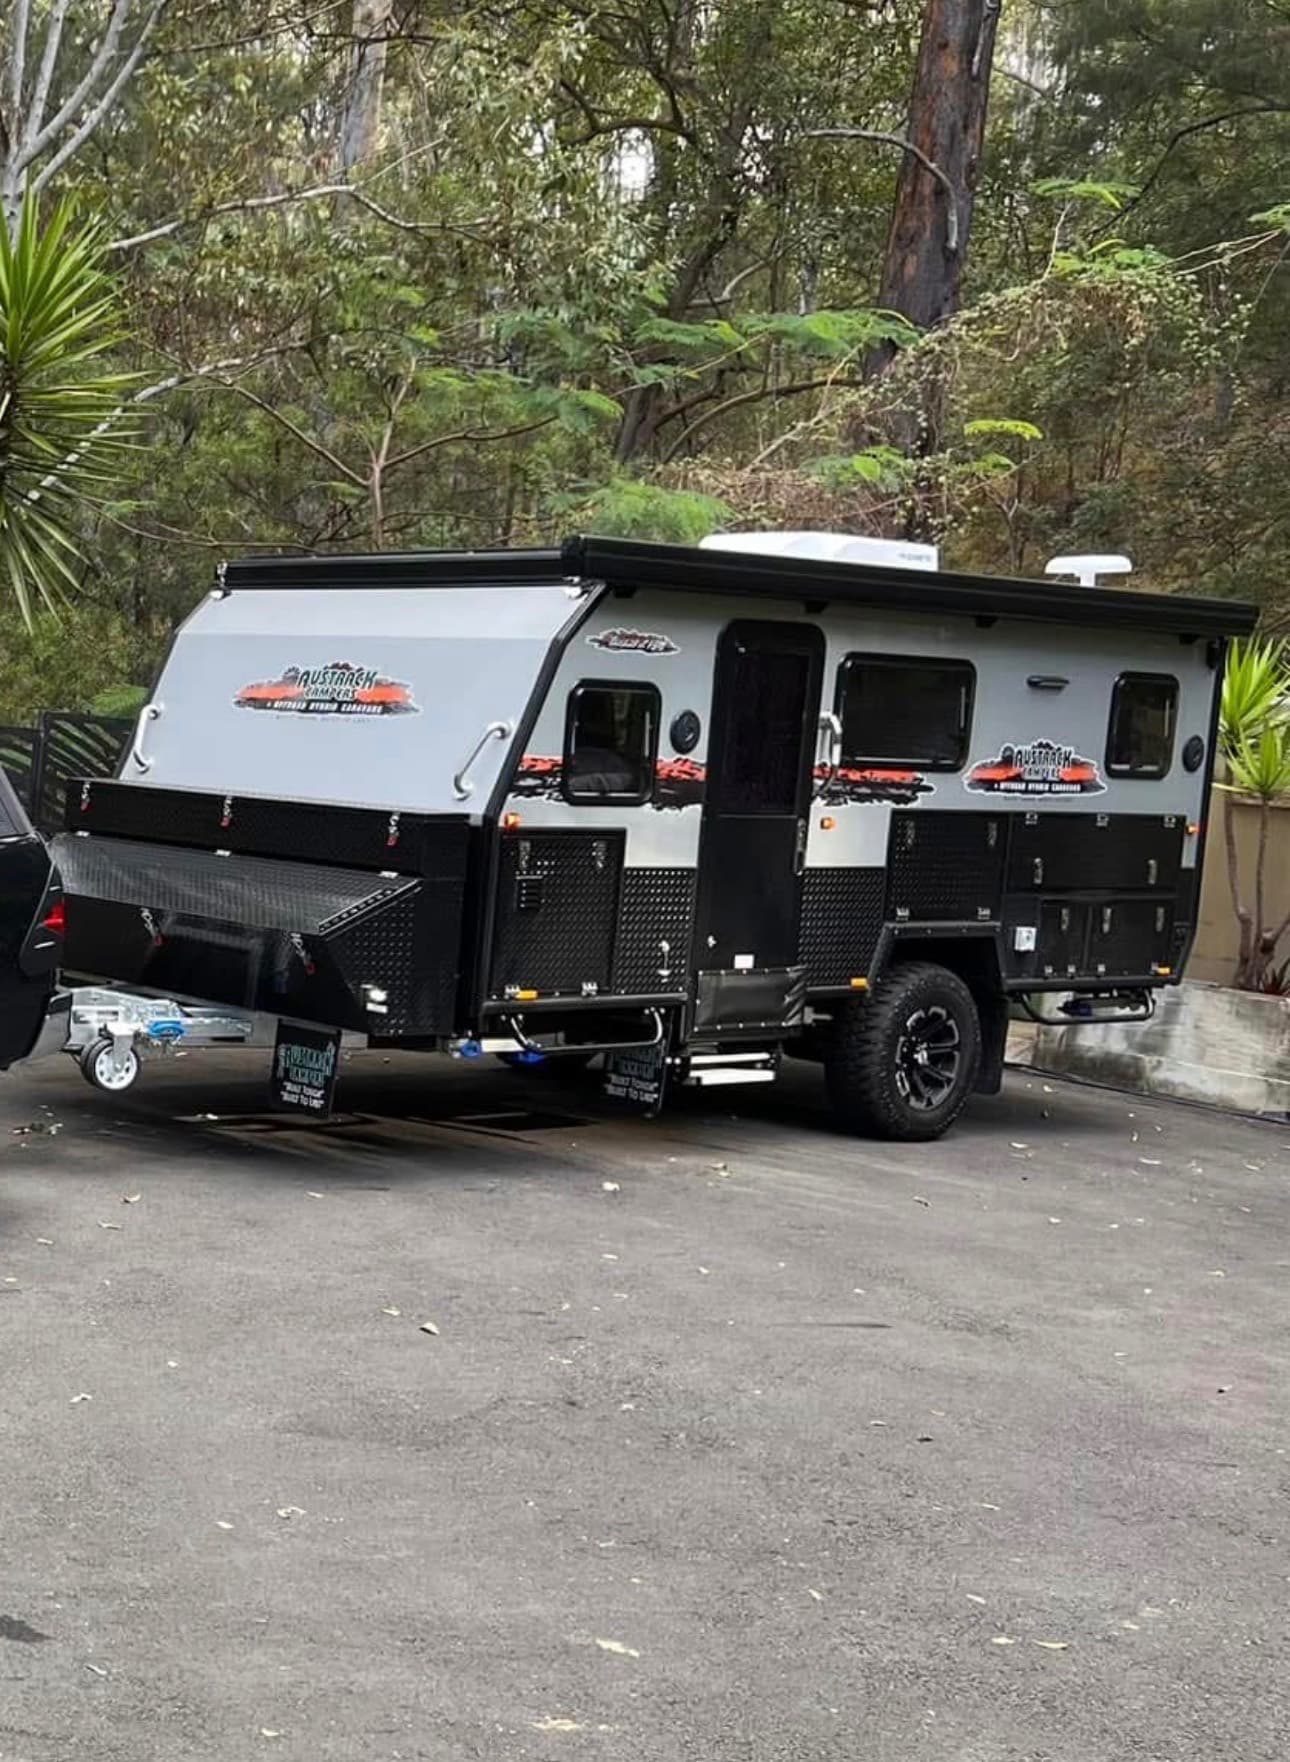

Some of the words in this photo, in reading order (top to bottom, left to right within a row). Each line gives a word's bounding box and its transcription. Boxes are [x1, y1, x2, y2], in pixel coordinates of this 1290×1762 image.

[297, 669, 378, 689] AUSTRACK
[304, 687, 358, 700] CAMPERS
[308, 702, 339, 712] HYBRID
[1014, 749, 1073, 768] AUSTRACK
